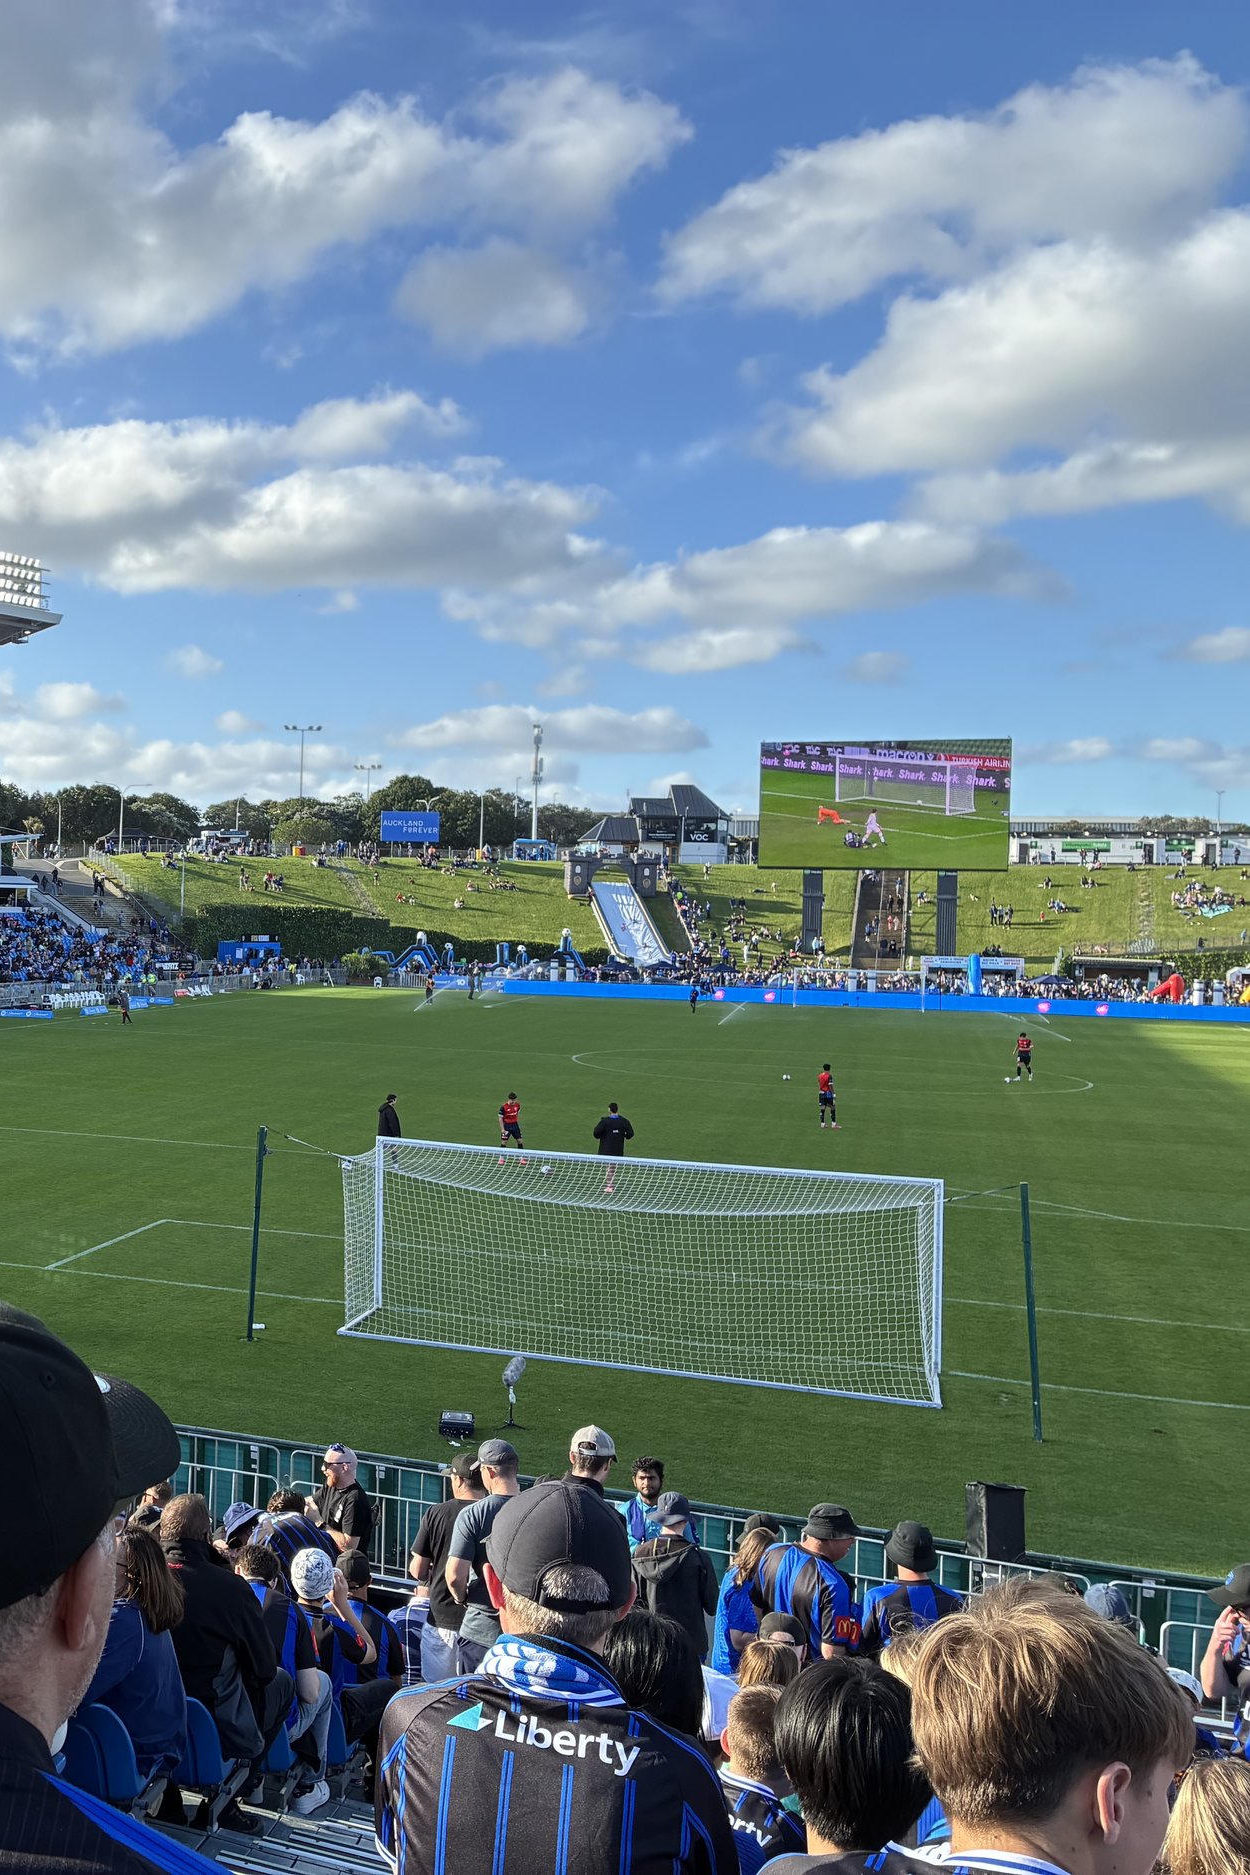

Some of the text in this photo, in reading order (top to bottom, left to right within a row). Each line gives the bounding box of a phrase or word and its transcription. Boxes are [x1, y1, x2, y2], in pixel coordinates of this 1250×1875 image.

[876, 750, 926, 760] macron
[690, 833, 709, 841] VOC
[494, 1709, 641, 1777] Liberty
